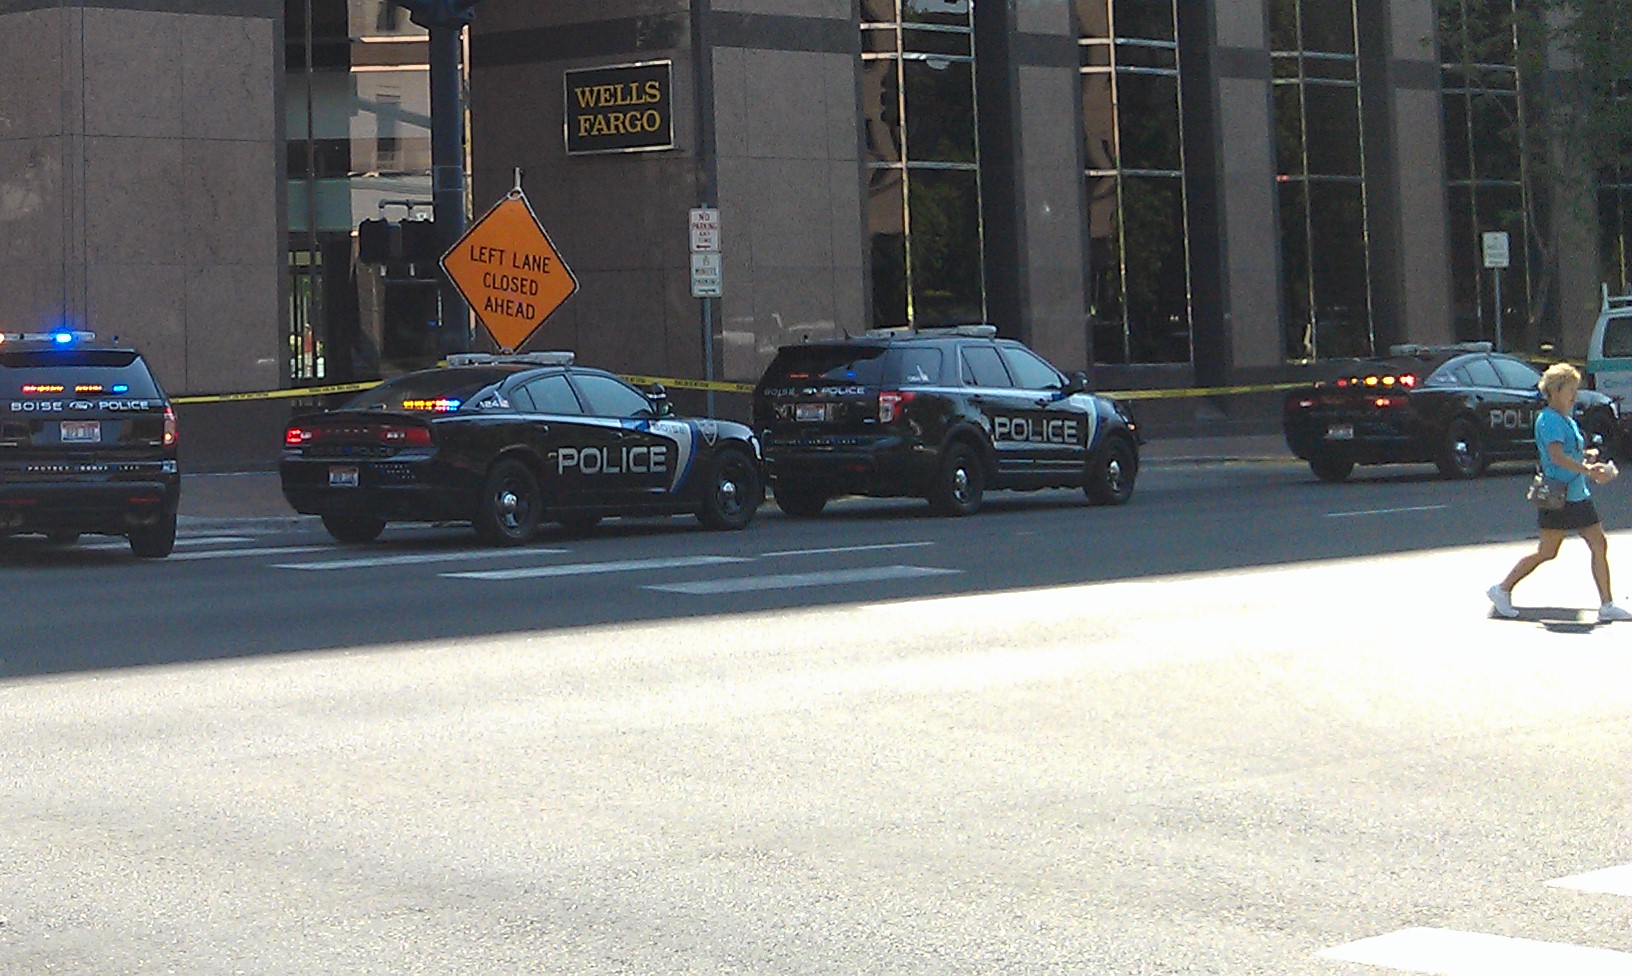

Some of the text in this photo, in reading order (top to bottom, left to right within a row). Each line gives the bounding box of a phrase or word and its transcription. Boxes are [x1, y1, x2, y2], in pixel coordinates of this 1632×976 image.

[575, 80, 661, 108] WELLS
[578, 109, 661, 136] FARGO
[470, 245, 551, 274] LEFT LANE
[483, 272, 538, 296] CLOSED
[484, 296, 535, 320] AHEAD
[821, 386, 865, 395] POLICE
[11, 401, 149, 411] BOISE POLICE
[994, 416, 1078, 443] POLICE
[1490, 410, 1536, 429] POLI
[558, 446, 667, 475] POLICE
